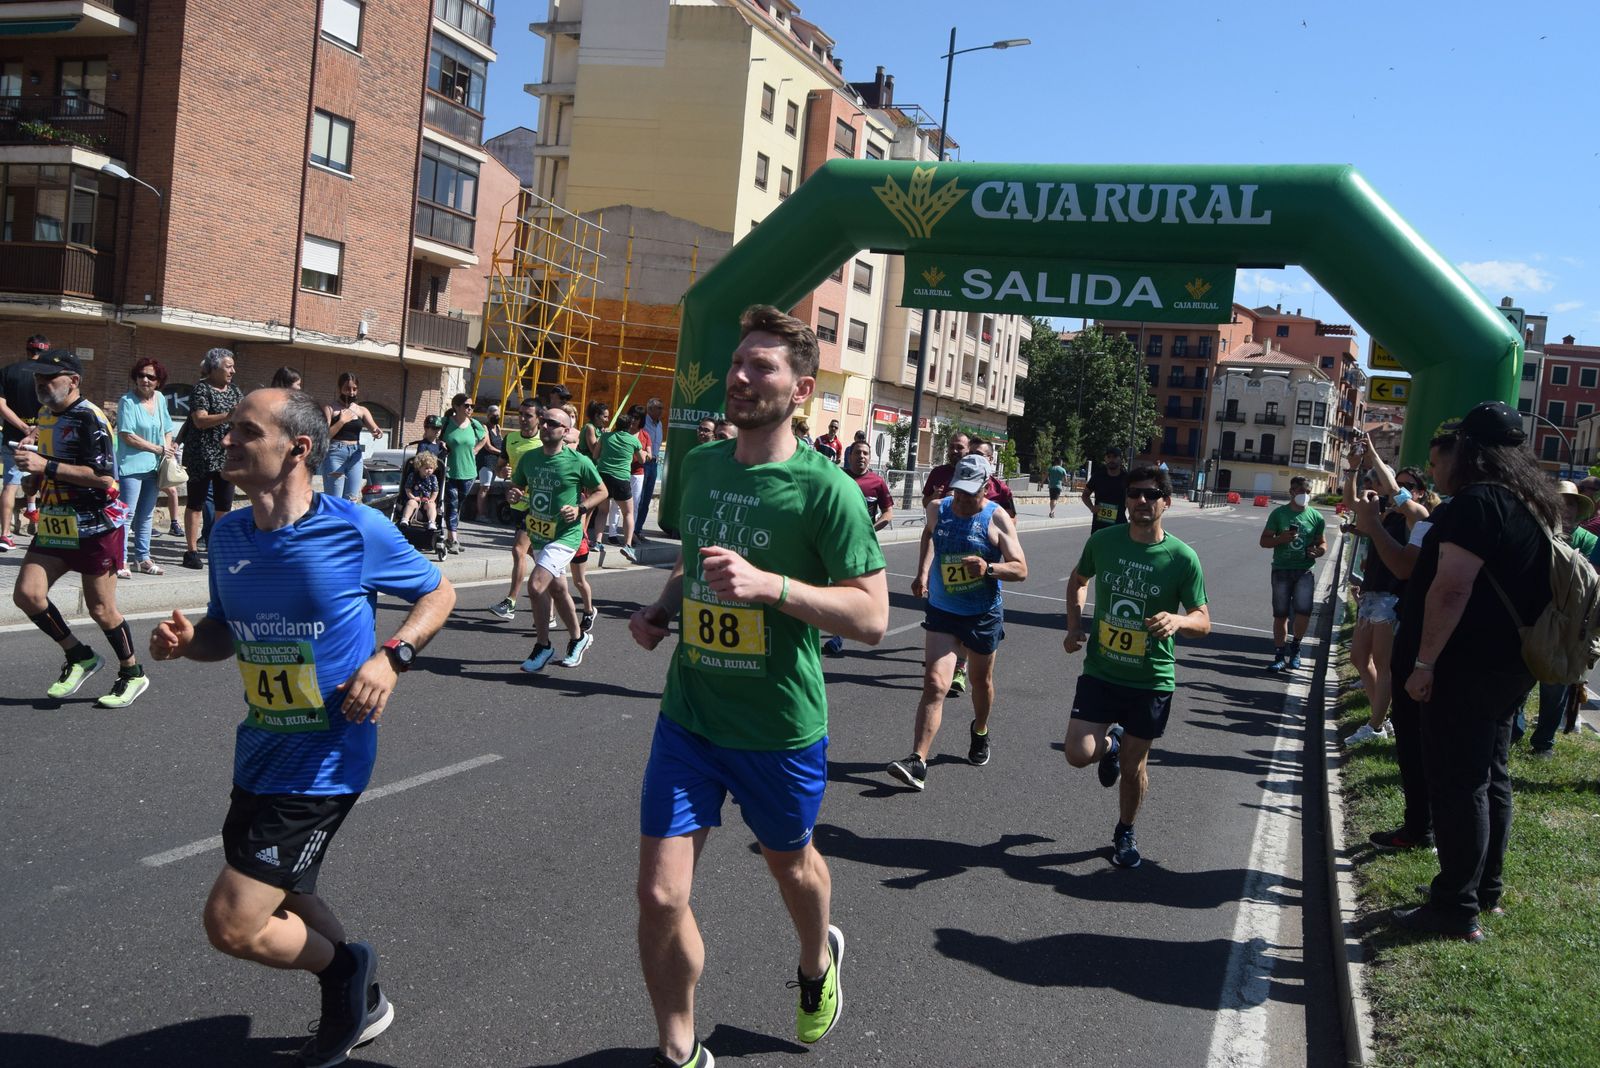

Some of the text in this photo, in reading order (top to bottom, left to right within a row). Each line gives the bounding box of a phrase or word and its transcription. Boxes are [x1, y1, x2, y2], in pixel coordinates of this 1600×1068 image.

[971, 181, 1272, 225] CAJA RURAL
[929, 289, 952, 297] RURAL
[960, 268, 1163, 309] SALIDA
[1192, 302, 1219, 310] RURAL
[722, 492, 760, 507] CARRERA
[43, 517, 70, 535] 181
[529, 518, 550, 536] 212
[255, 612, 280, 621] GRUPO
[250, 616, 326, 640] norclamp
[698, 608, 740, 648] 88
[1108, 627, 1133, 651] 79
[701, 655, 761, 670] CAJA RURAL
[258, 670, 294, 705] 41
[264, 714, 323, 726] CAJA RURAL
[255, 852, 280, 867] adidas
